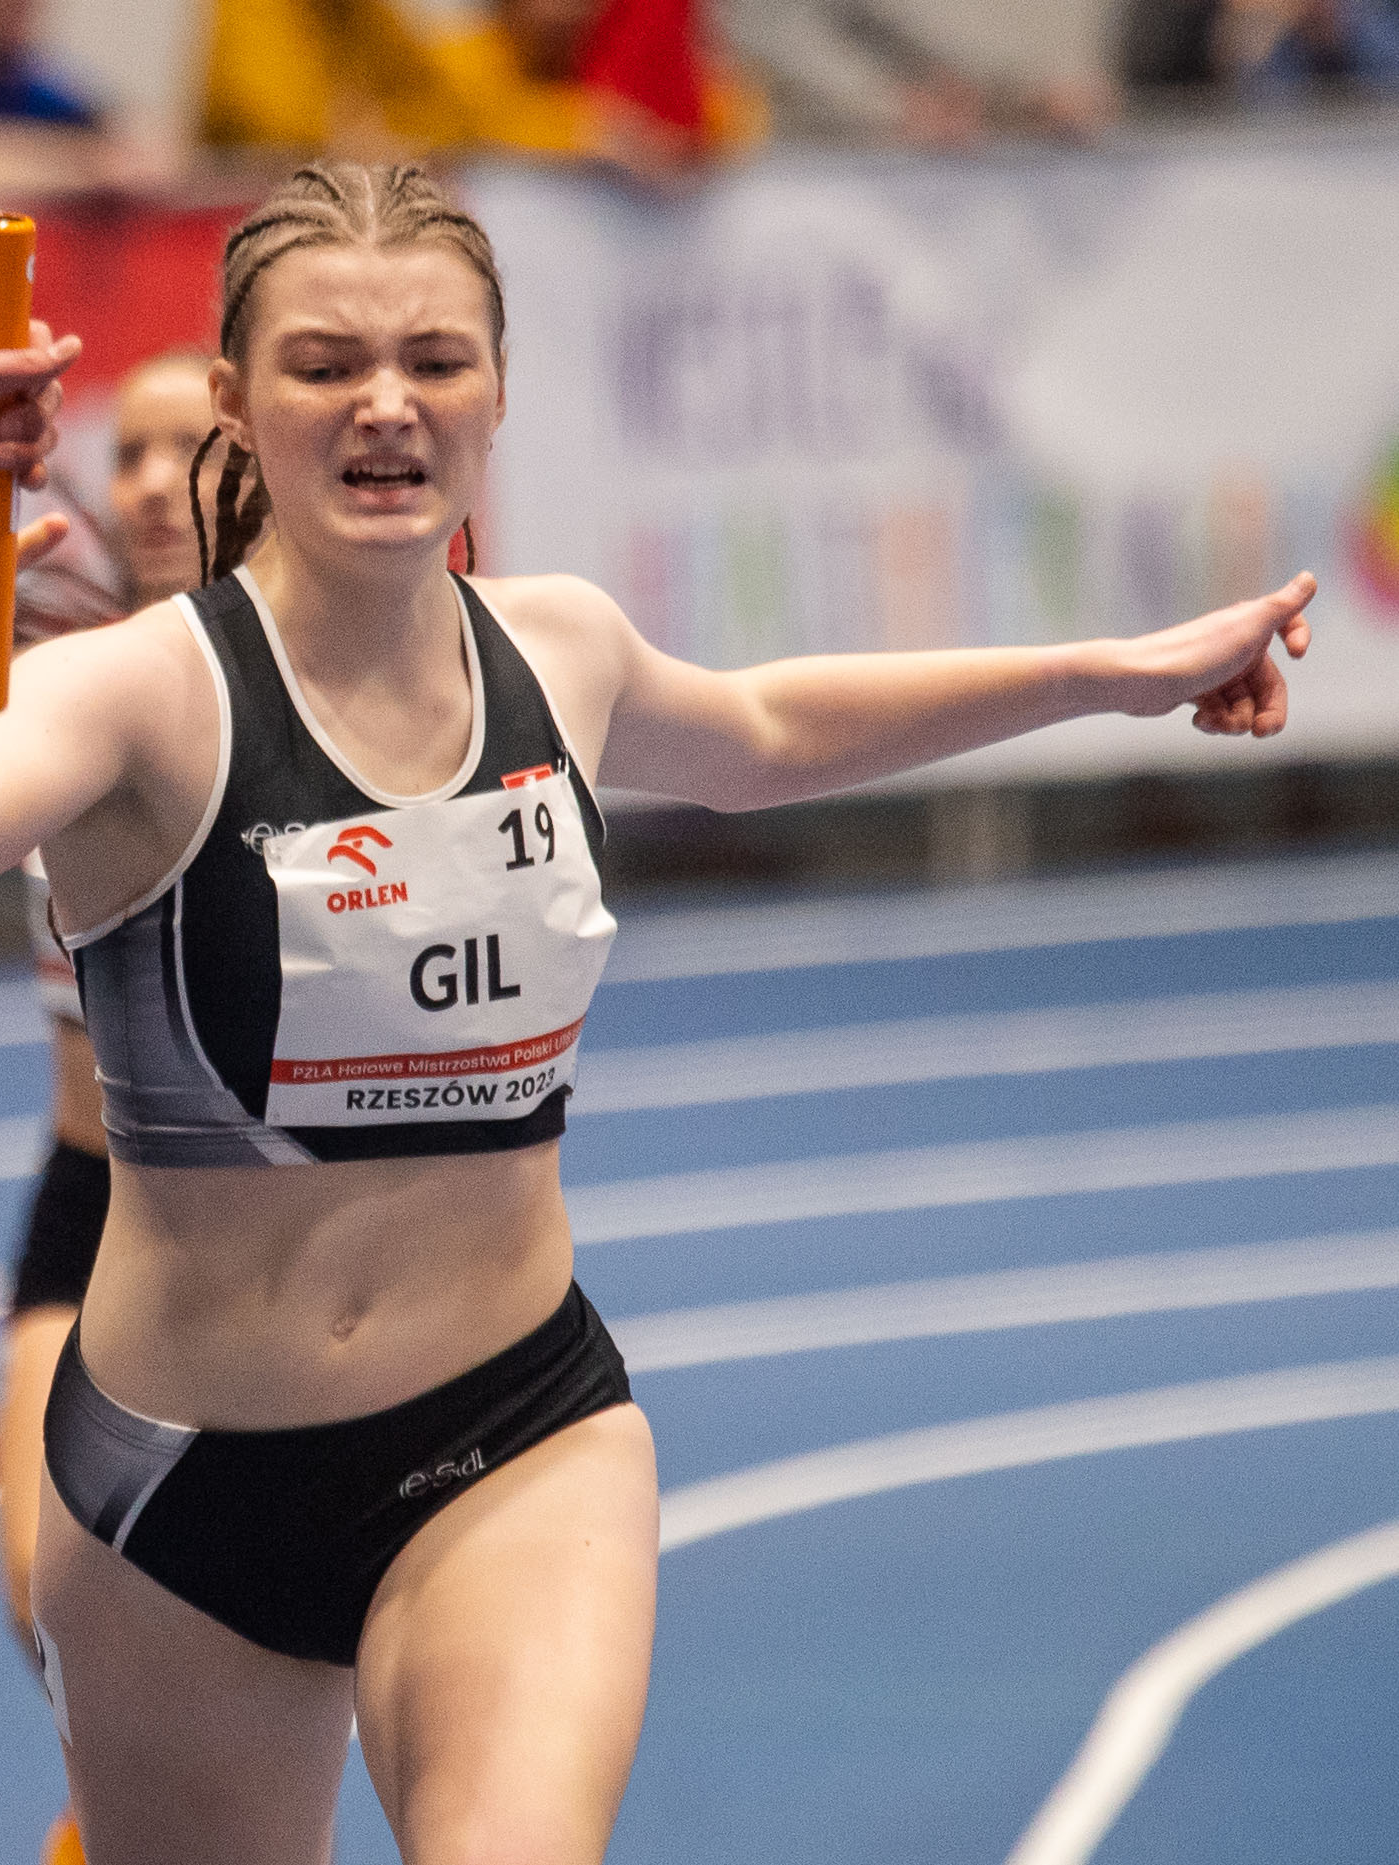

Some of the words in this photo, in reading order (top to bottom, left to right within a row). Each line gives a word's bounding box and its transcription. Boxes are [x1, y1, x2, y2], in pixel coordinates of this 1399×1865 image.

[498, 801, 556, 871] 19
[326, 882, 408, 914] ORLEN
[409, 933, 521, 1013] GIL
[408, 1050, 511, 1074] Mistrzostwa
[514, 1038, 553, 1064] Polski
[346, 1080, 498, 1111] RZESZÓW
[506, 1067, 556, 1104] 2023
